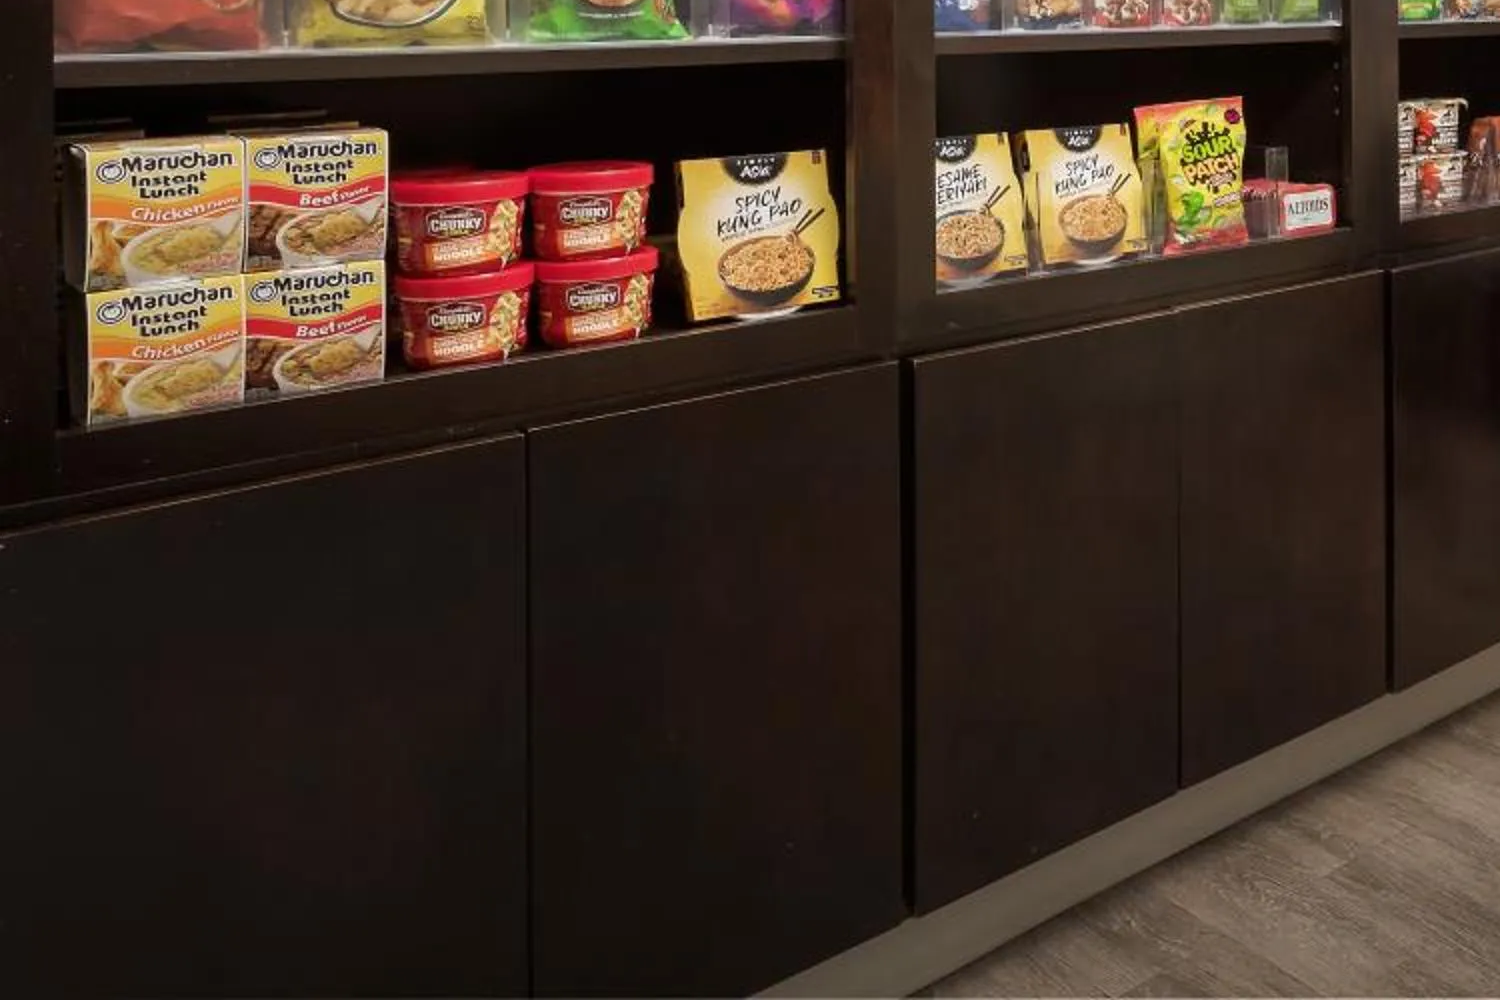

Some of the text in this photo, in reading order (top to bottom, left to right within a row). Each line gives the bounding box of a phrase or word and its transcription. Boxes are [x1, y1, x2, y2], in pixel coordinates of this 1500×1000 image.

[278, 140, 378, 159] Maruchan
[1182, 135, 1236, 164] SOUR
[122, 151, 233, 173] Maruchan
[285, 158, 354, 173] Instant
[1065, 154, 1099, 176] SPICY
[1183, 152, 1239, 183] PATCH
[131, 171, 207, 187] Instant
[294, 171, 347, 185] Lunch
[937, 163, 981, 188] ESAME
[1055, 164, 1115, 195] KUNG PAO
[140, 184, 199, 199] Lunch
[299, 191, 338, 207] Beef
[735, 186, 781, 214] SPICY
[937, 178, 987, 205] ERIYAKI
[131, 203, 204, 222] Chicken
[716, 209, 762, 237] KUNG
[769, 197, 802, 221] PAO
[431, 217, 483, 232] CHUNKY
[273, 270, 375, 291] Maruchan
[122, 286, 233, 311] Maruchan
[281, 288, 351, 306] Instant
[131, 307, 207, 326] Instant
[289, 301, 343, 317] Lunch
[430, 311, 483, 326] CHUNKY
[140, 320, 200, 338] Lunch
[296, 322, 335, 338] Beef
[131, 340, 204, 360] Chicken
